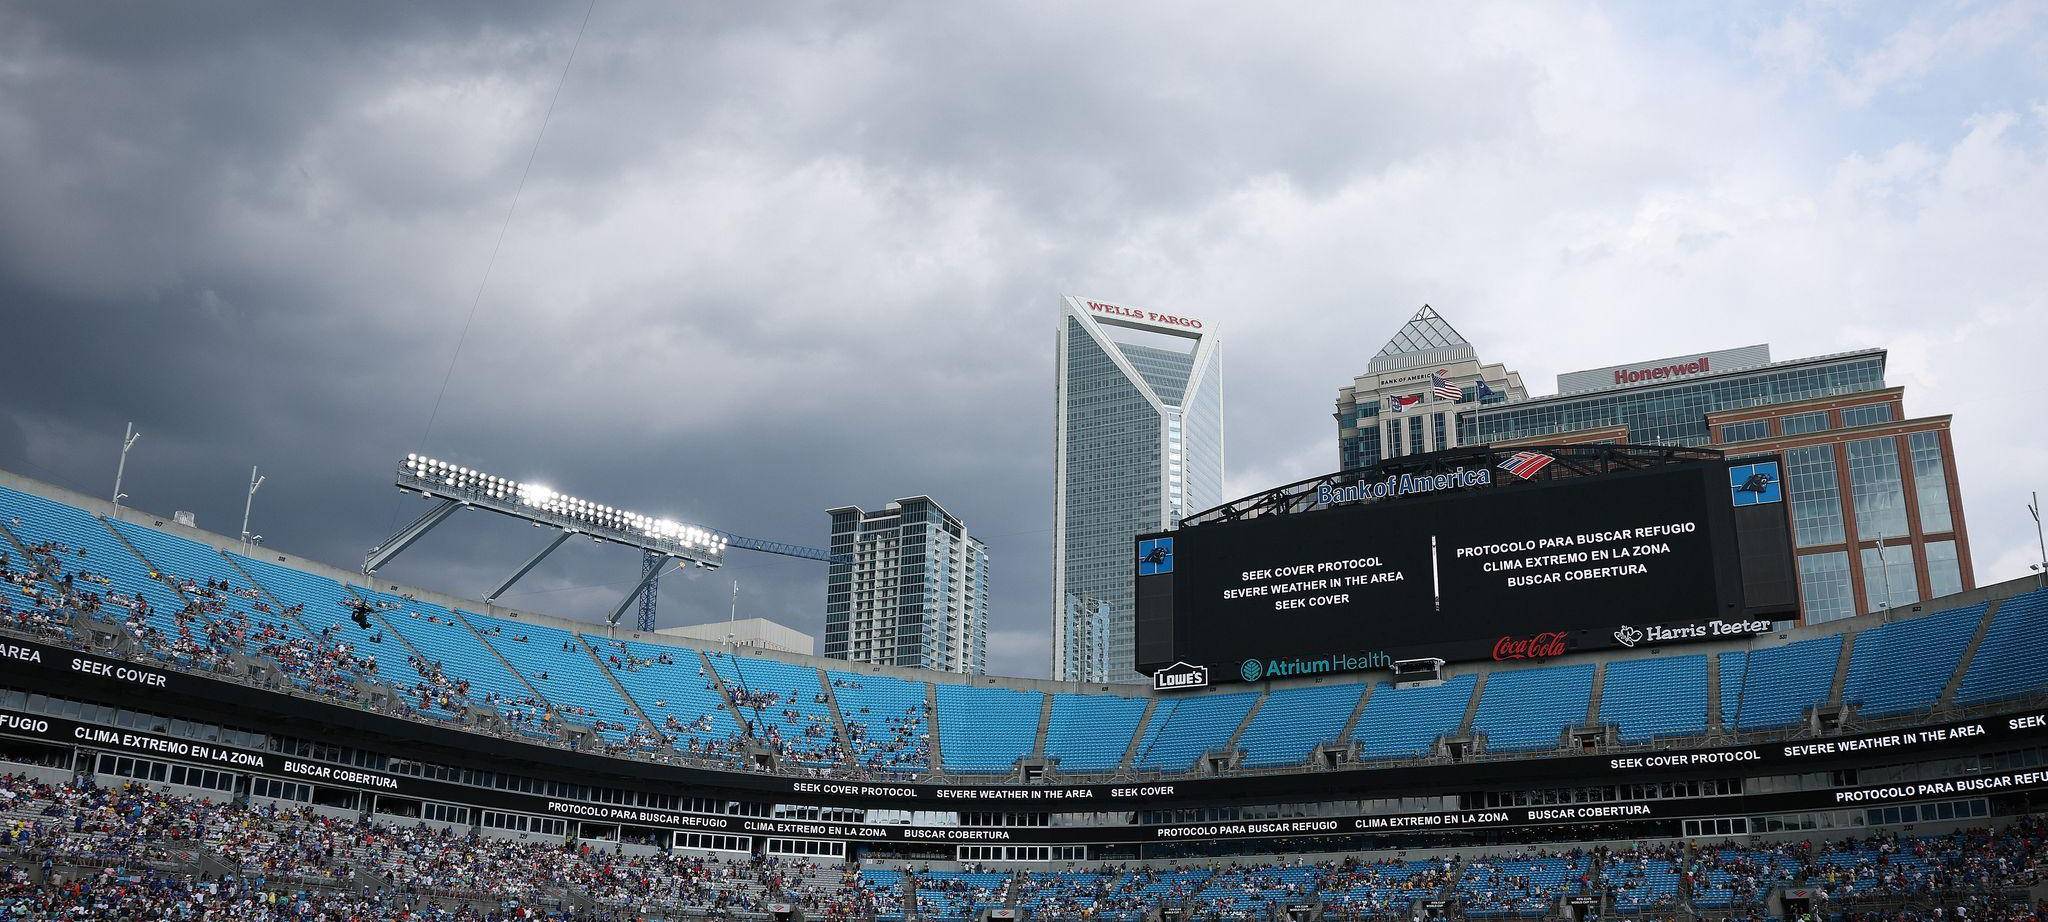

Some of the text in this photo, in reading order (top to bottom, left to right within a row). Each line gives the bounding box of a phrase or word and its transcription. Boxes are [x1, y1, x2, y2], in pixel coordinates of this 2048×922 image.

[1086, 301, 1203, 329] WELLS FARGO
[1614, 357, 1710, 385] Honeywell
[1317, 466, 1491, 505] Bank of America
[1456, 522, 1696, 558] PROTOCOLO PARA BUSCAR REFUGIO
[1241, 556, 1383, 581] SEEK COVER PROTOCOL
[1483, 542, 1671, 572] CLIMA EXTREMO EN LA ZONA
[1223, 571, 1404, 600] SEVERE WEATHER IN THE AREA
[1507, 563, 1648, 588] BUSCAR COBERTURA
[1275, 593, 1350, 611] SEEK COVER
[1645, 618, 1772, 642] Harris Teeter
[0, 643, 41, 663] AREA
[1491, 631, 1568, 661] Coca-Cola
[71, 658, 167, 688] SEEK COVER
[1266, 650, 1392, 677] Atrium Health
[1158, 670, 1203, 687] LOWE'S
[2008, 714, 2047, 730] SEEK
[74, 726, 264, 768] CLIMA EXTREMO EN LA ZONA
[1784, 724, 1986, 757] SEVERE WEATHER IN THE AREA
[1610, 750, 1761, 769] SEEK COVER PROTOCOL
[283, 760, 398, 789] BUSCAR COBERTURA
[793, 782, 918, 797] SEEK COVER PROTOCOL
[936, 789, 1093, 799] SEVERE WEATHER IN THE AREA
[1111, 786, 1174, 797] SEEK COVER
[1836, 785, 1916, 803] PROTOCOLO
[1918, 782, 1955, 795] PARA
[1956, 775, 2012, 792] BUSCAR
[548, 801, 728, 828] PROTOCOLO PARA BUSCAR REFUGIO
[1355, 812, 1509, 829] CLIMA EXTREMO EN LA ZONA
[1527, 804, 1651, 820] BUSCAR COBERTURA
[744, 821, 887, 837] CLIMA EXTREMO EN LA ZONA
[904, 829, 1010, 840] BUSCAR COBERTURA
[1157, 820, 1338, 837] PROTOCOLO PARA BUSCAR REFUGIO
